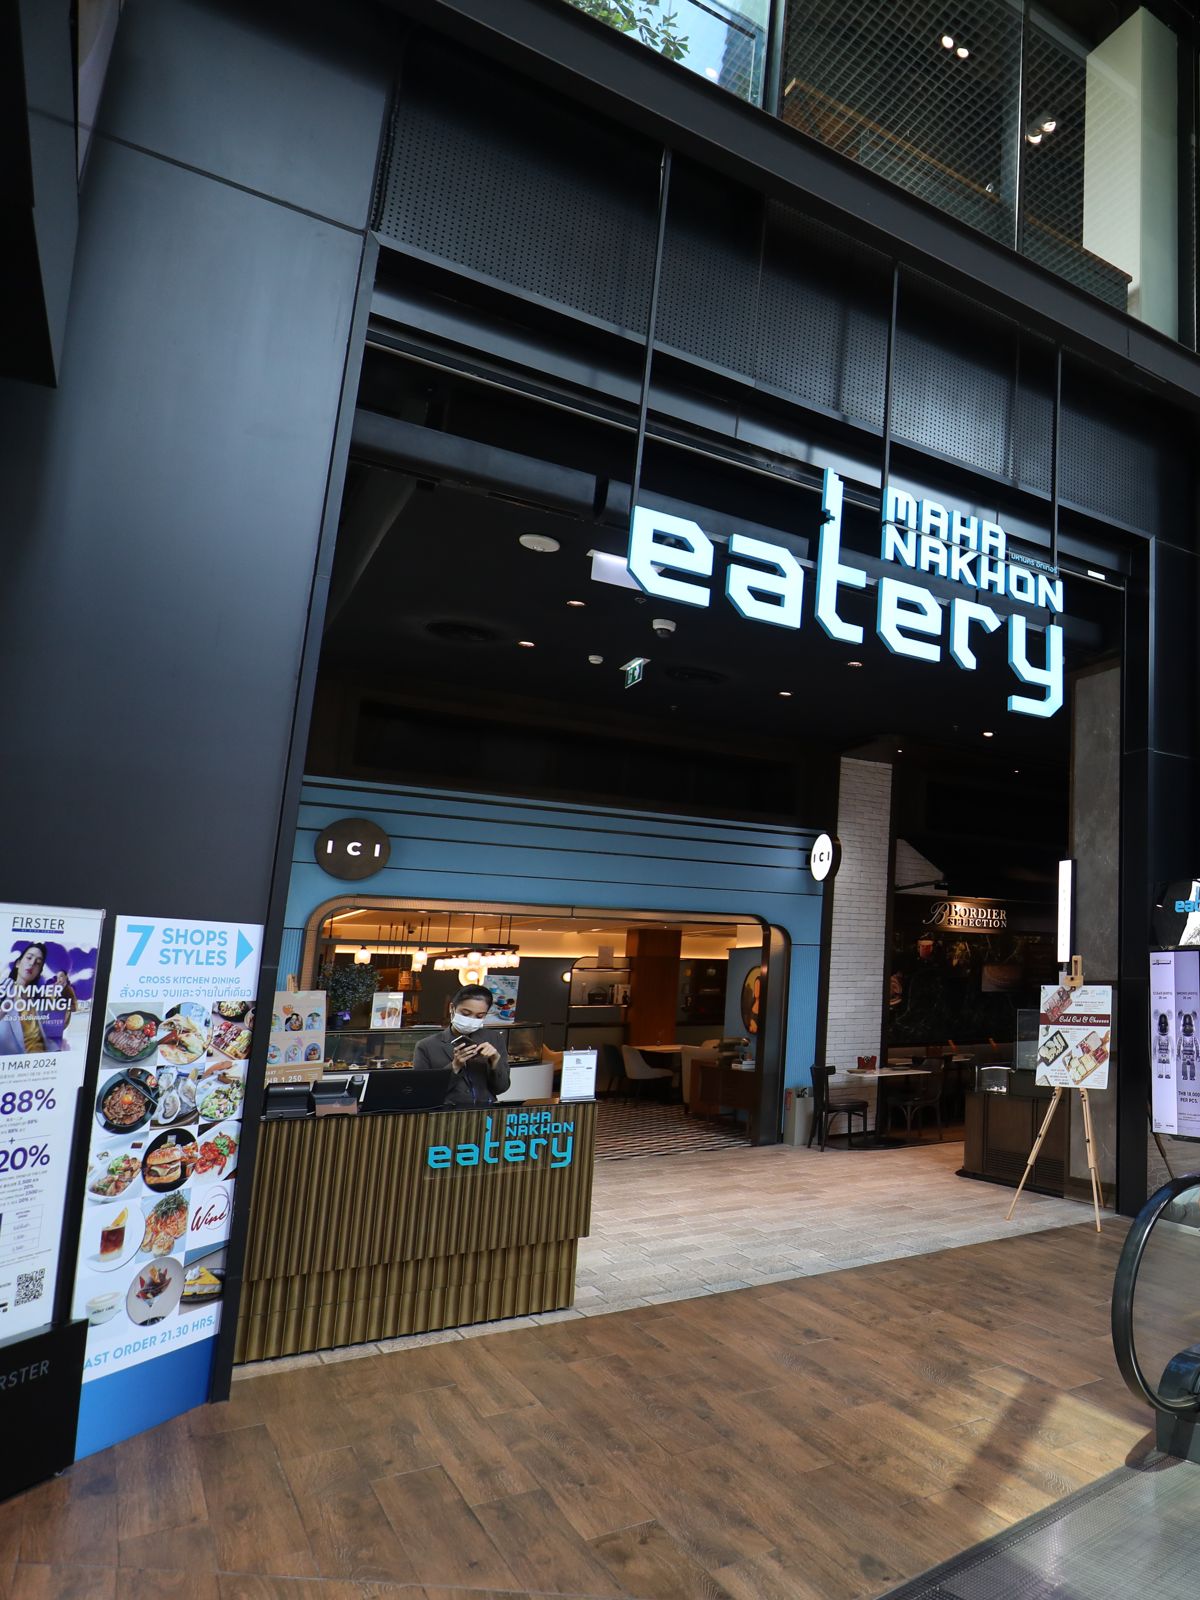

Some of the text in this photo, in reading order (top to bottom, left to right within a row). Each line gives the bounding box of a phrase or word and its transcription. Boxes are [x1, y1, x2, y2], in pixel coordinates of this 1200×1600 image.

[882, 486, 1007, 558] MAHA
[882, 524, 1064, 613] NAKHON
[627, 467, 1063, 718] eatery
[326, 840, 380, 857] ICI
[813, 851, 830, 863] ICI
[951, 903, 1007, 920] BORDIER
[12, 917, 65, 930] FIRSTER
[949, 917, 1007, 928] SELECTION
[126, 924, 155, 966] 7
[162, 928, 228, 946] SHOPS
[159, 948, 227, 966] STYLES
[139, 976, 171, 984] CROSS
[0, 984, 63, 998] SUMMER
[0, 998, 72, 1012] OOMING!
[1059, 1015, 1071, 1023] Cold
[8, 1060, 31, 1070] MAR
[33, 1058, 57, 1069] 2024
[506, 1111, 551, 1125] MAHA
[505, 1121, 575, 1137] NAKHON
[427, 1115, 573, 1169] eatery
[190, 1203, 227, 1232] Wine
[83, 1315, 215, 1370] AST ORDER 21.30 HRS.
[0, 1359, 50, 1390] RSTER
